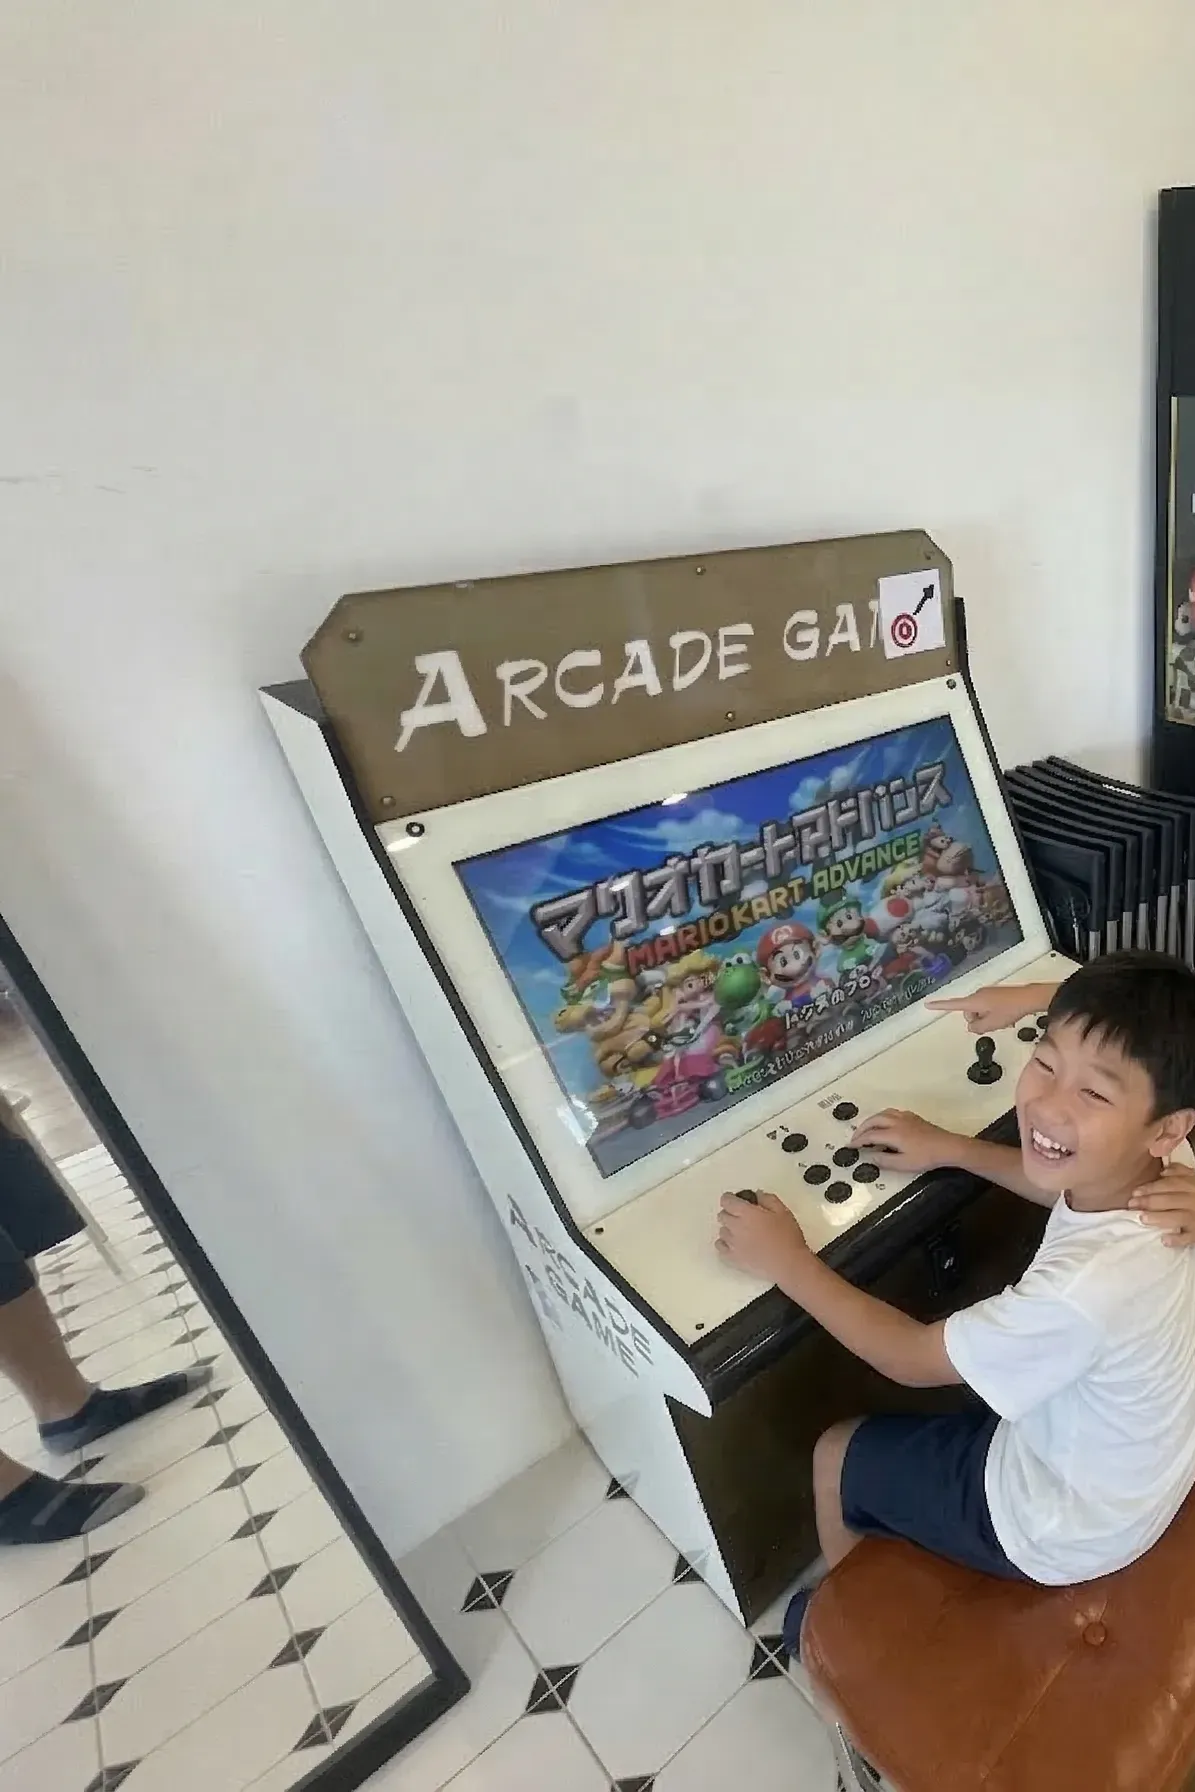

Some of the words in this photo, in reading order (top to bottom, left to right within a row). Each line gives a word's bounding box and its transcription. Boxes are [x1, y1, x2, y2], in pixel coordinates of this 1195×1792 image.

[394, 623, 754, 752] ARCADE
[783, 600, 882, 660] GA
[812, 832, 921, 896] ADVANCE
[507, 1193, 654, 1365] ARCADE
[545, 1265, 640, 1379] GAME
